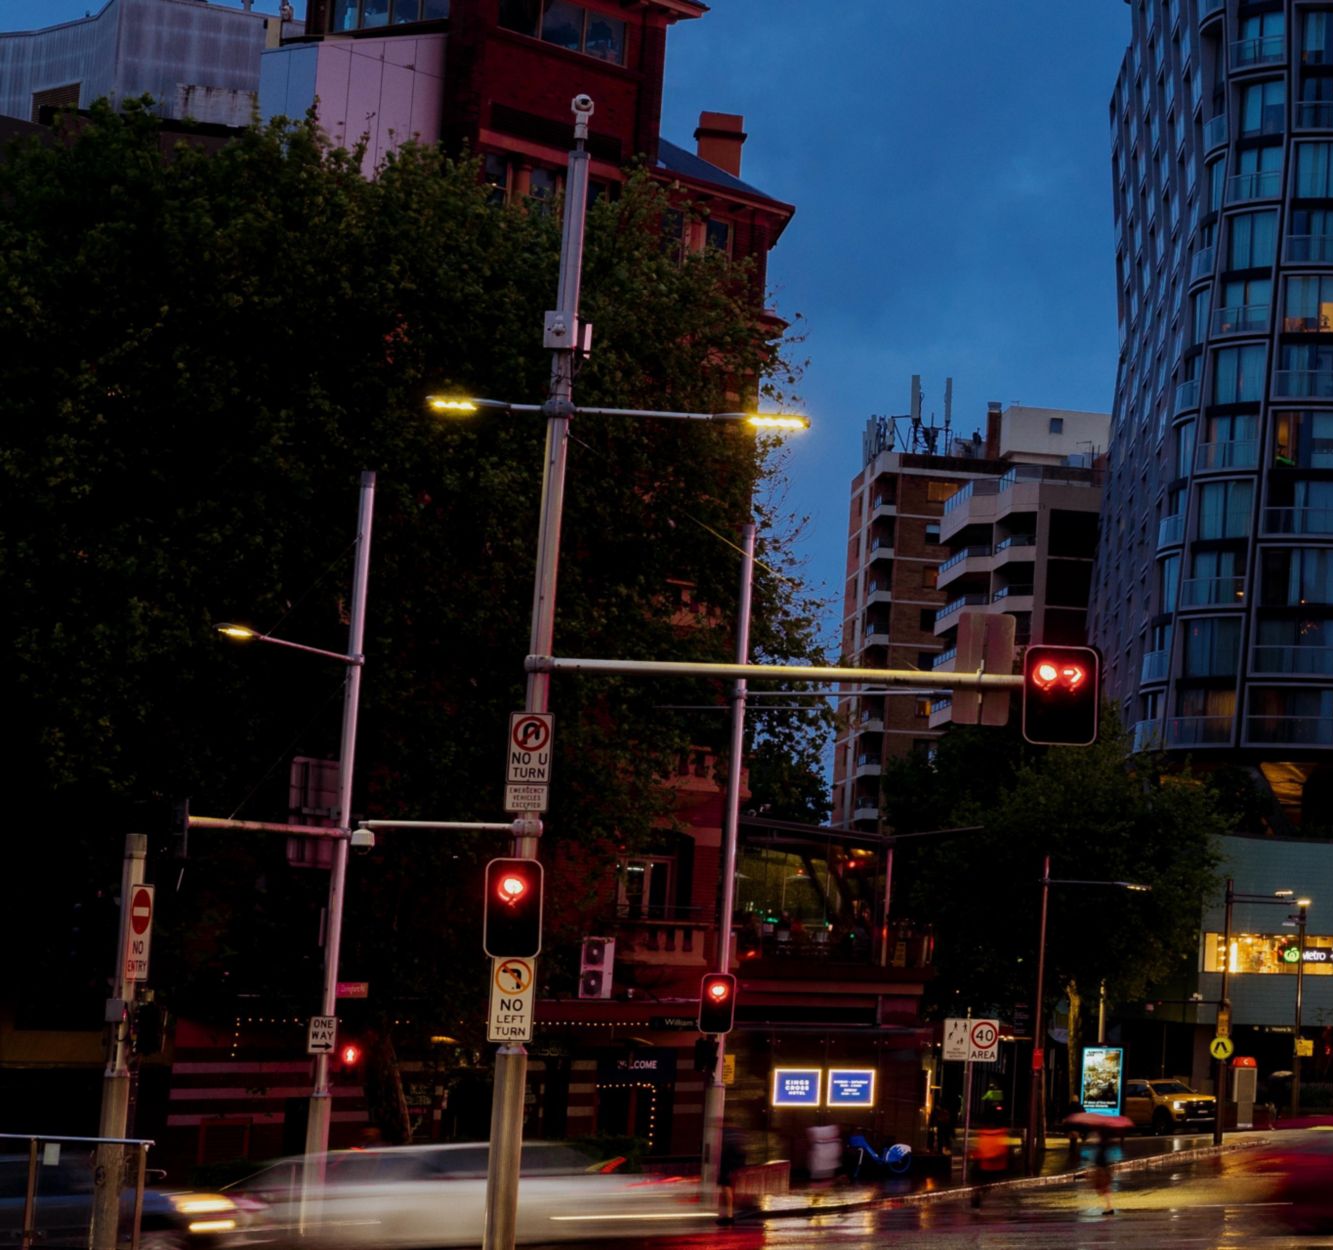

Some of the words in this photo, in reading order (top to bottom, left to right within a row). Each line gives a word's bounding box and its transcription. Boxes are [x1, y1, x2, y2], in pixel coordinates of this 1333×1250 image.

[511, 751, 531, 765] NO
[538, 752, 548, 765] U
[513, 767, 545, 778] TURN
[509, 786, 545, 794] EMERGENCY
[132, 940, 144, 954] NO
[127, 960, 146, 972] ENTRY
[500, 998, 524, 1012] NO
[313, 1019, 334, 1029] ONE
[496, 1014, 525, 1024] LEFT
[665, 1018, 694, 1027] William
[311, 1031, 334, 1040] WAY
[495, 1026, 526, 1036] TURN
[975, 1029, 994, 1042] 40
[971, 1050, 996, 1060] AREA
[617, 1060, 657, 1069] COME
